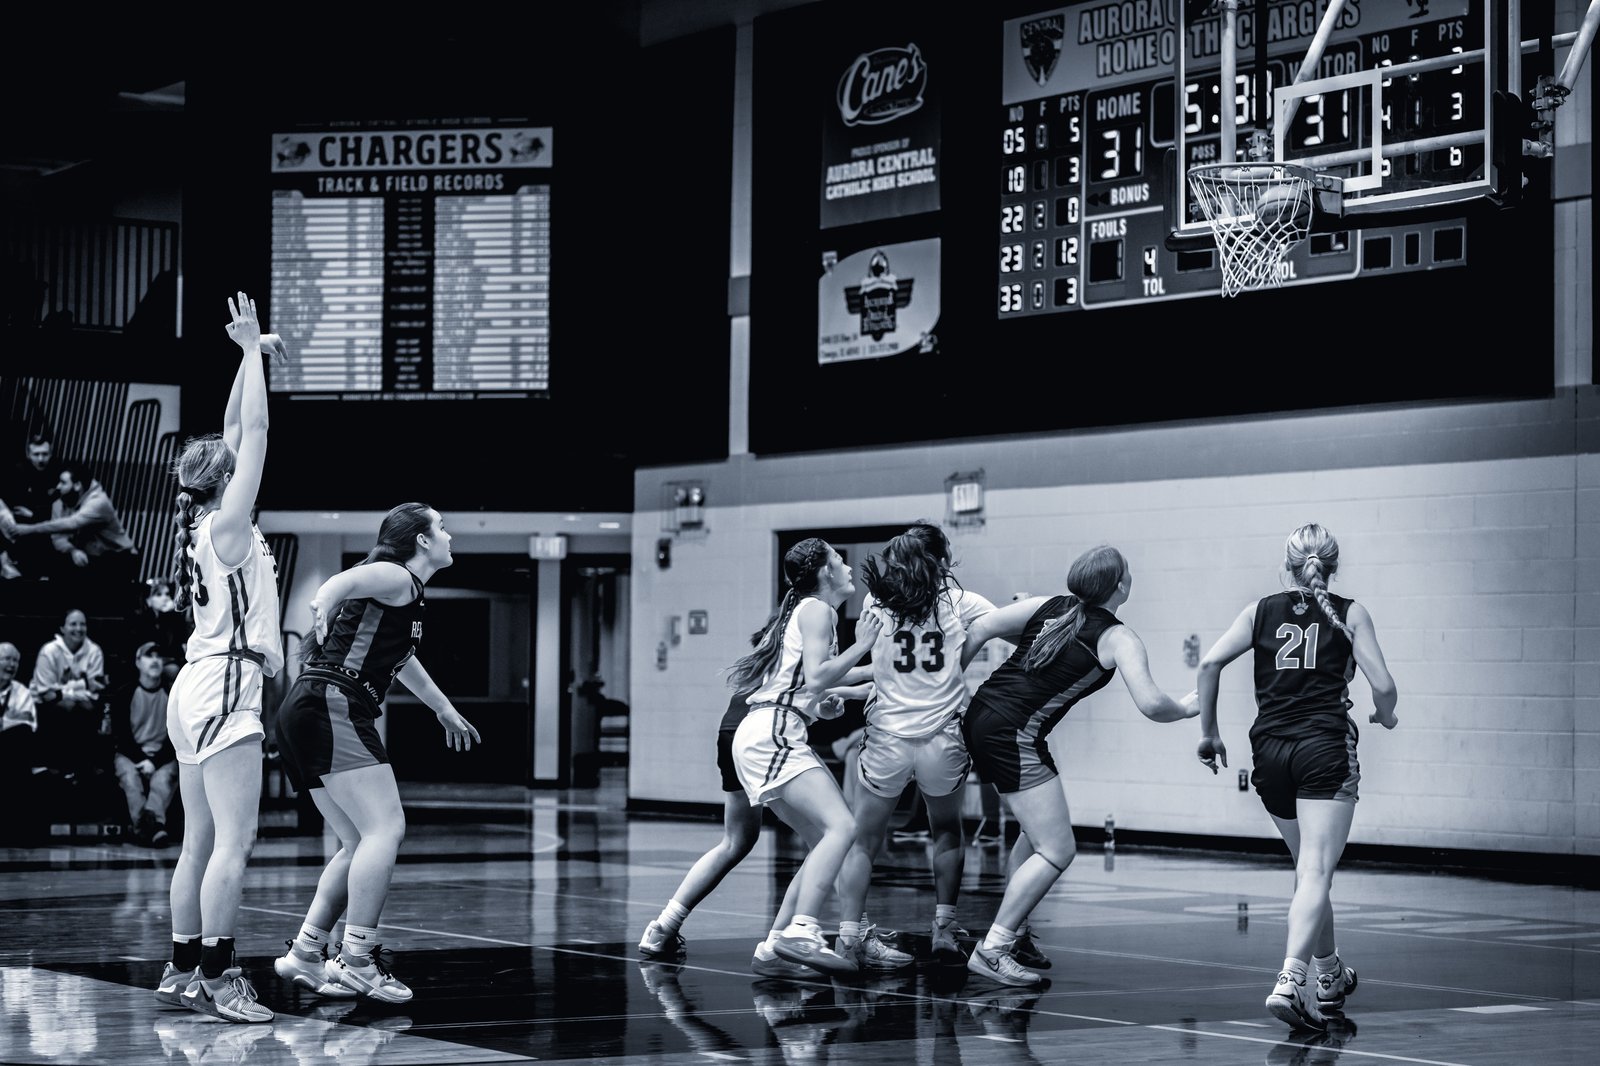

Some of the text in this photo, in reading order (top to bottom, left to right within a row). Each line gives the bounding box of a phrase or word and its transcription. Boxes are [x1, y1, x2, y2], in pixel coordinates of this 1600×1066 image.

[1078, 1, 1164, 45] AURORA
[1372, 21, 1464, 54] NO F PTS
[1097, 32, 1158, 78] HOME
[1189, 16, 1222, 59] TH
[1009, 95, 1080, 122] NO F PTS
[1097, 92, 1141, 121] HOME
[1303, 89, 1349, 147] 31
[1451, 91, 1463, 120] 3
[318, 132, 503, 167] CHARGERS
[1003, 127, 1025, 154] 05
[1069, 116, 1080, 143] 5
[1100, 126, 1142, 179] 31
[318, 173, 504, 193] TRACK & FIELD RECORDS
[826, 147, 936, 185] AURORA CENTRAL
[897, 167, 936, 188] SCHOOL
[1008, 165, 1025, 192] 10
[1069, 156, 1080, 183] 3
[1110, 183, 1150, 206] BONUS
[1002, 205, 1024, 233] 22
[1067, 197, 1079, 224] 0
[1091, 218, 1127, 240] FOULS
[1000, 244, 1023, 273] 23
[1062, 237, 1078, 264] 12
[1144, 248, 1156, 274] 4
[1066, 277, 1078, 304] 3
[1142, 276, 1166, 297] TOL
[893, 630, 945, 674] 33
[1275, 622, 1320, 671] 21
